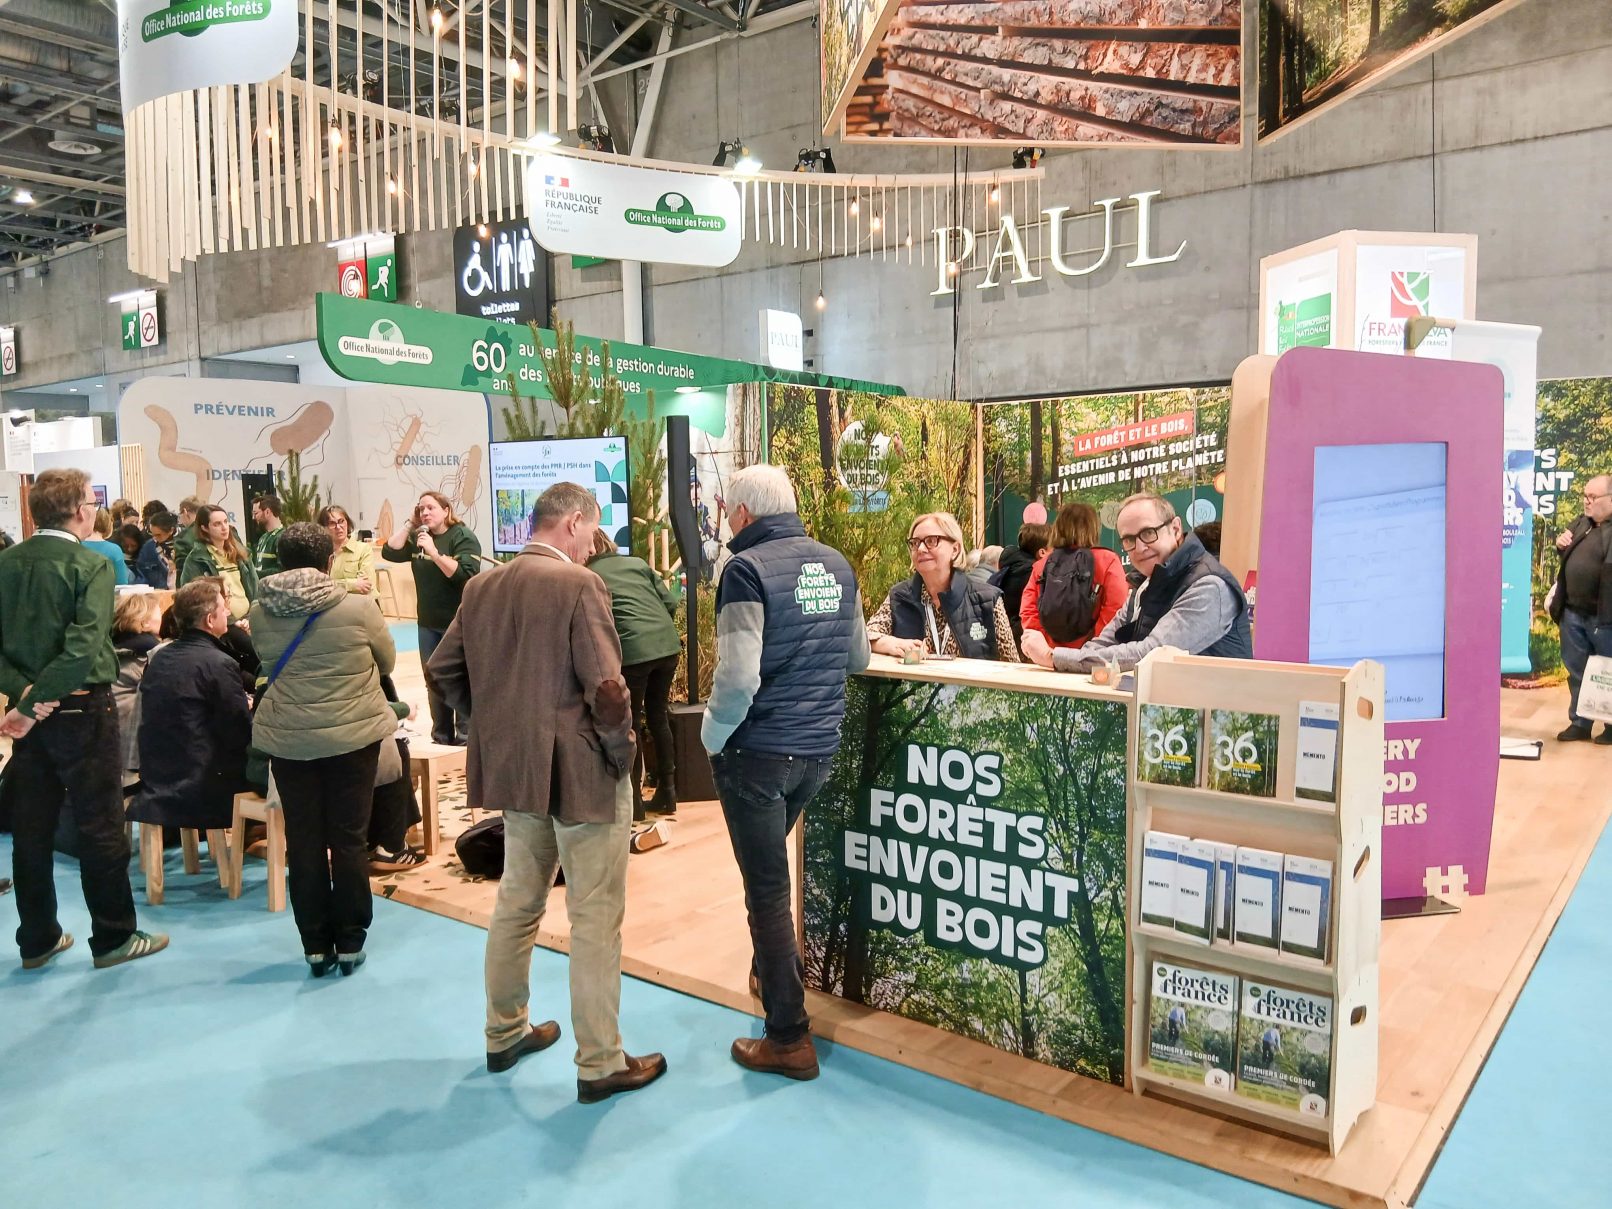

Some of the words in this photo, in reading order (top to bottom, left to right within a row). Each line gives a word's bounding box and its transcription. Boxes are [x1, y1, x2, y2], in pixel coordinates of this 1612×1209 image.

[145, 19, 165, 36] Office
[165, 5, 204, 28] National
[206, 4, 224, 19] des
[225, 0, 263, 17] Forêts
[545, 189, 602, 206] RÉPUBLIQUE
[545, 199, 599, 215] FRANÇAISE
[629, 211, 651, 223] Office
[651, 213, 684, 226] National
[684, 217, 697, 227] des
[698, 217, 721, 229] Forêts
[929, 190, 1187, 296] PAUL
[770, 331, 800, 349] PAUL
[1296, 323, 1330, 338] NATIONALE
[343, 340, 365, 353] Office
[365, 343, 395, 356] National
[395, 347, 407, 358] des
[408, 348, 429, 360] Forêts
[472, 339, 507, 373] 60
[518, 343, 535, 357] au
[586, 350, 601, 366] de
[616, 356, 655, 375] gestion
[657, 359, 695, 379] durable
[519, 363, 543, 381] des
[194, 402, 276, 418] PRÉVENIR
[1078, 439, 1092, 452] LA
[1094, 430, 1127, 449] FORÊT
[1128, 428, 1142, 441] ET
[1144, 425, 1158, 438] LE
[1160, 418, 1188, 435] BOIS,
[395, 455, 460, 467] CONSEILLER
[1058, 454, 1118, 477] ESSENTIELS
[1120, 447, 1128, 465] À
[1131, 444, 1166, 462] NOTRE
[1169, 431, 1217, 454] SOCIÉTÉ
[1047, 482, 1060, 496] ET
[1062, 478, 1070, 493] À
[1071, 472, 1116, 491] L'AVENIR
[1118, 468, 1131, 482] DE
[1133, 462, 1169, 479] NOTRE
[1172, 449, 1224, 472] PLANÈTE
[804, 563, 826, 576] NOS
[797, 585, 842, 600] ENVOIENT
[805, 600, 817, 611] DU
[818, 598, 840, 611] BOIS
[1144, 725, 1188, 764] 36
[1214, 731, 1258, 771] 36
[907, 744, 1002, 797] NOS
[869, 788, 1045, 860] FORÊTS
[844, 830, 1079, 919] ENVOIENT
[871, 882, 922, 931] DU
[936, 897, 1045, 964] BOIS
[1163, 977, 1229, 1006] france
[1172, 969, 1229, 995] forêts
[1256, 998, 1326, 1028] france
[1266, 989, 1327, 1018] forêts
[1243, 1064, 1278, 1079] PREMIERS
